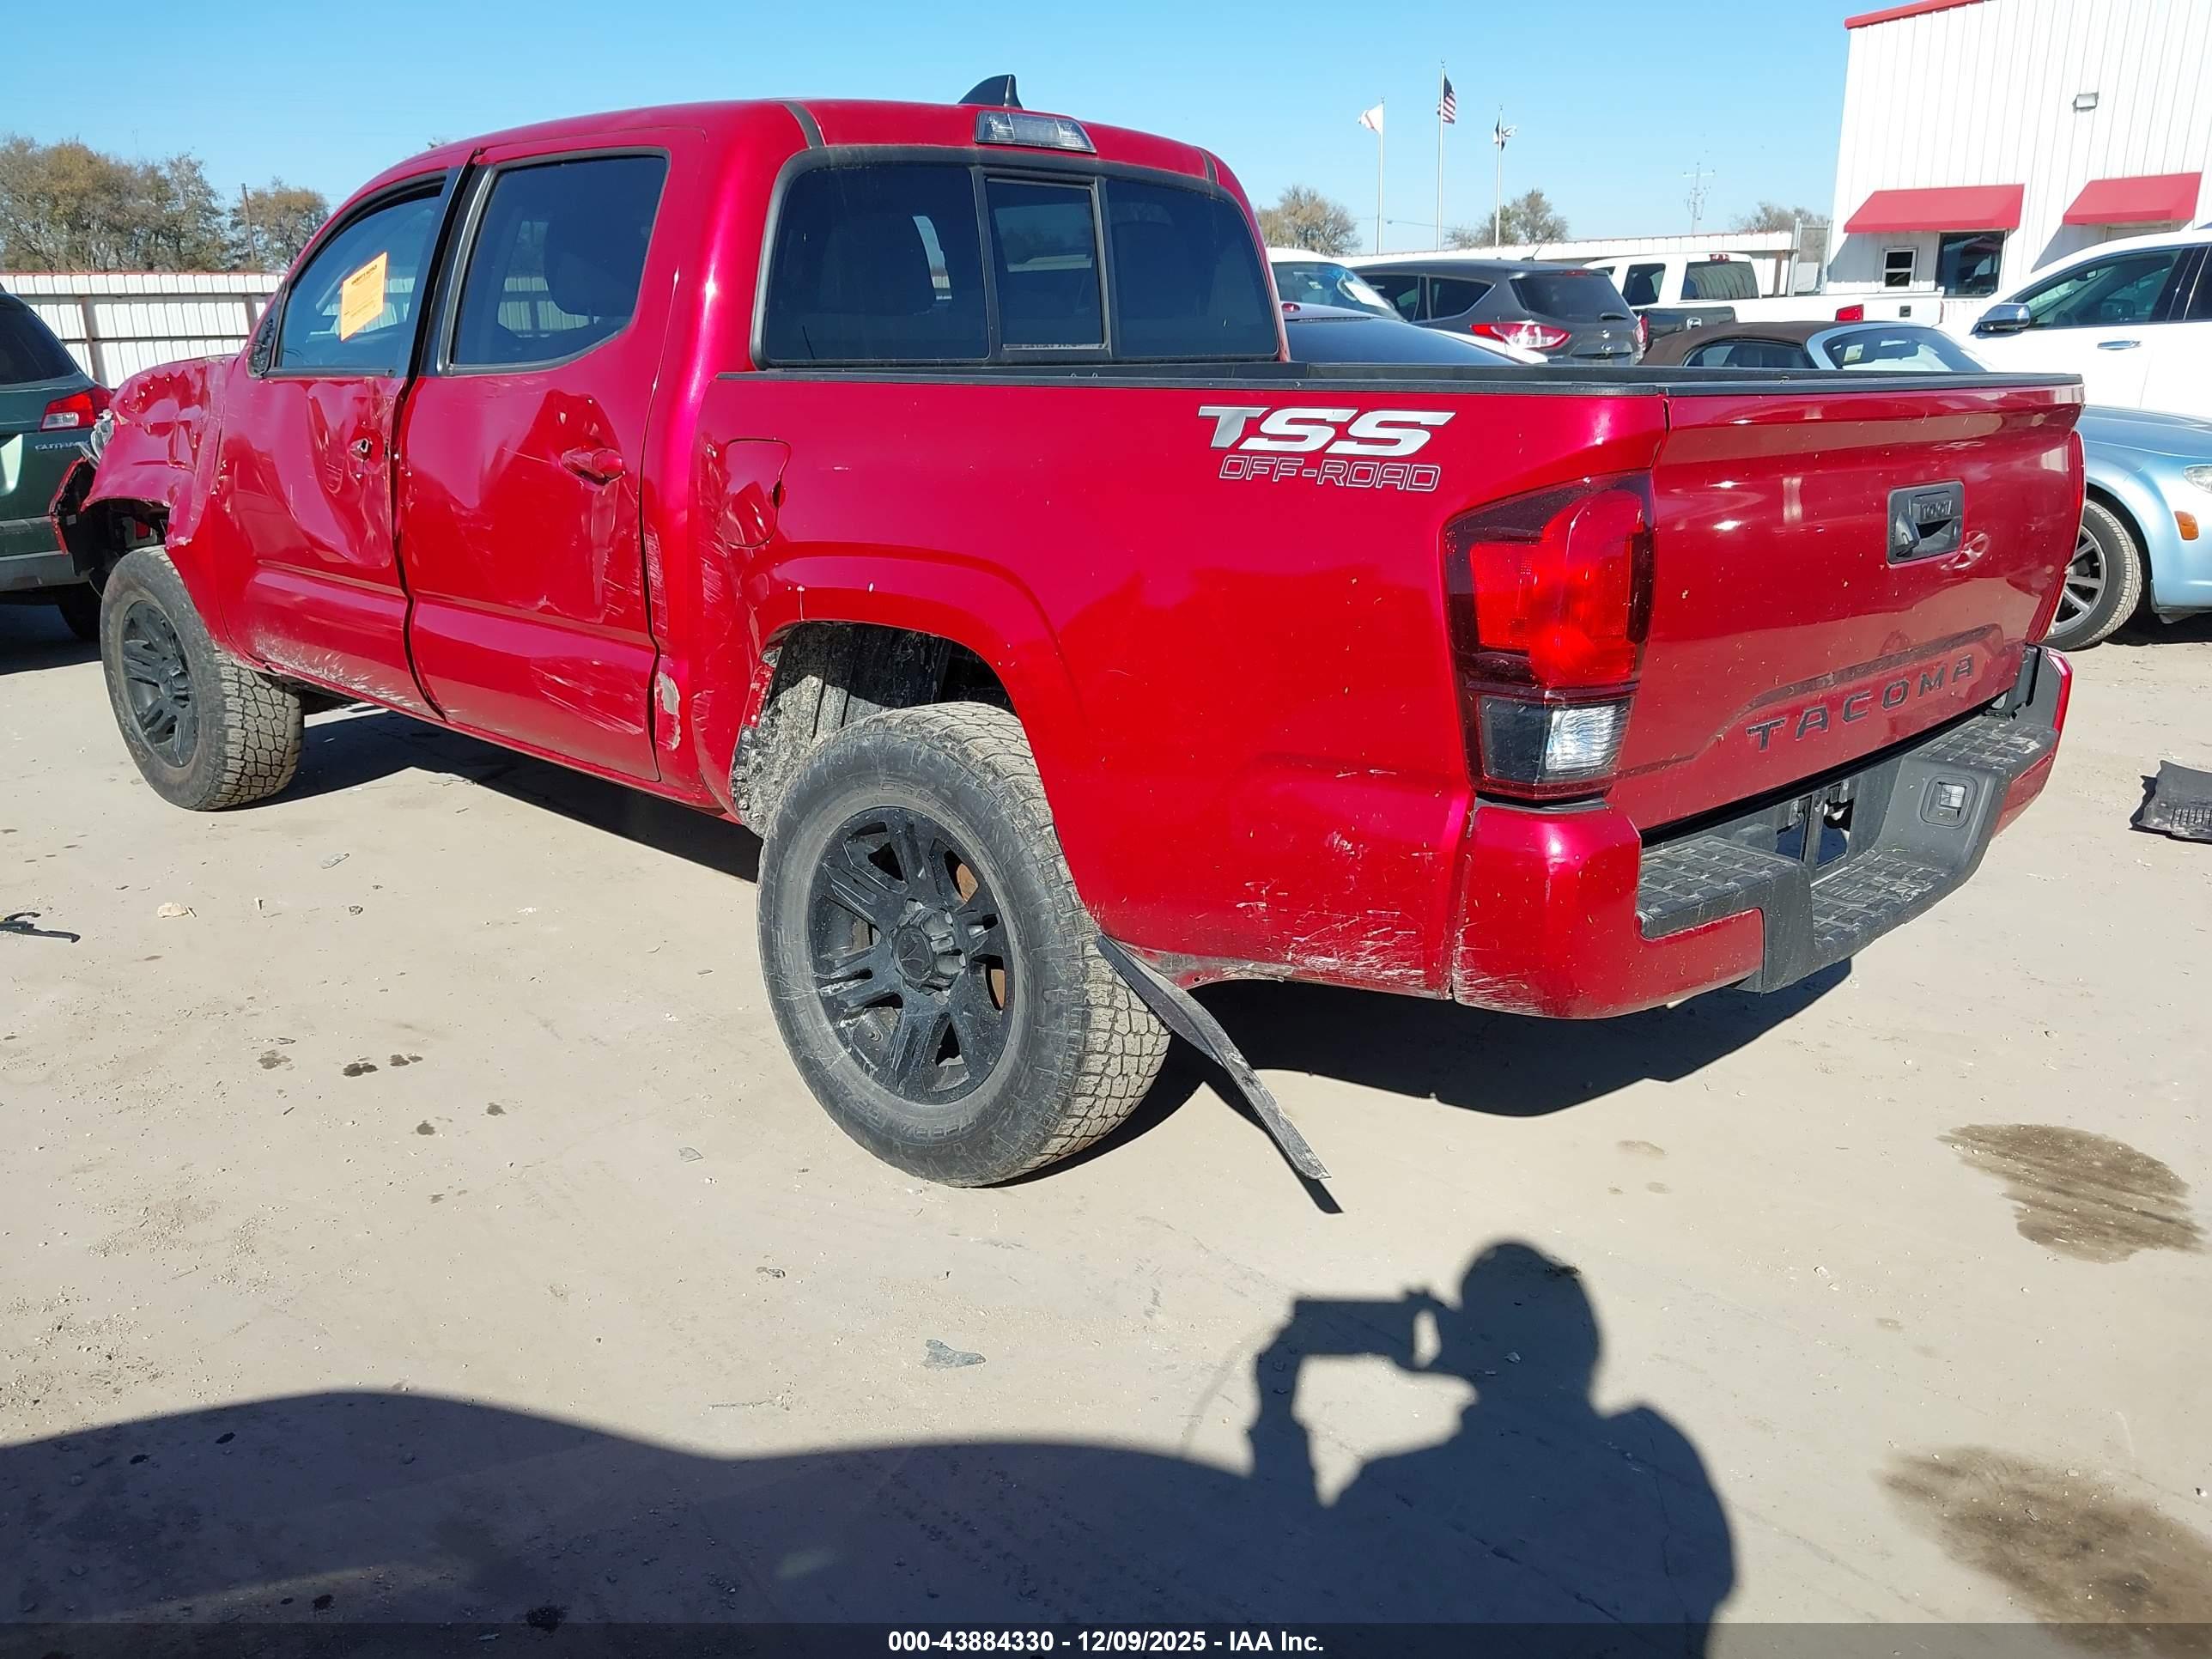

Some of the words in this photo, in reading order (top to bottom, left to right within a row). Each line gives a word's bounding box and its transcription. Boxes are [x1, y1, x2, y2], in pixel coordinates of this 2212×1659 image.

[1198, 405, 1456, 457] TSS
[1218, 454, 1441, 492] OFF-ROAD
[1746, 653, 1975, 751] TACOMA
